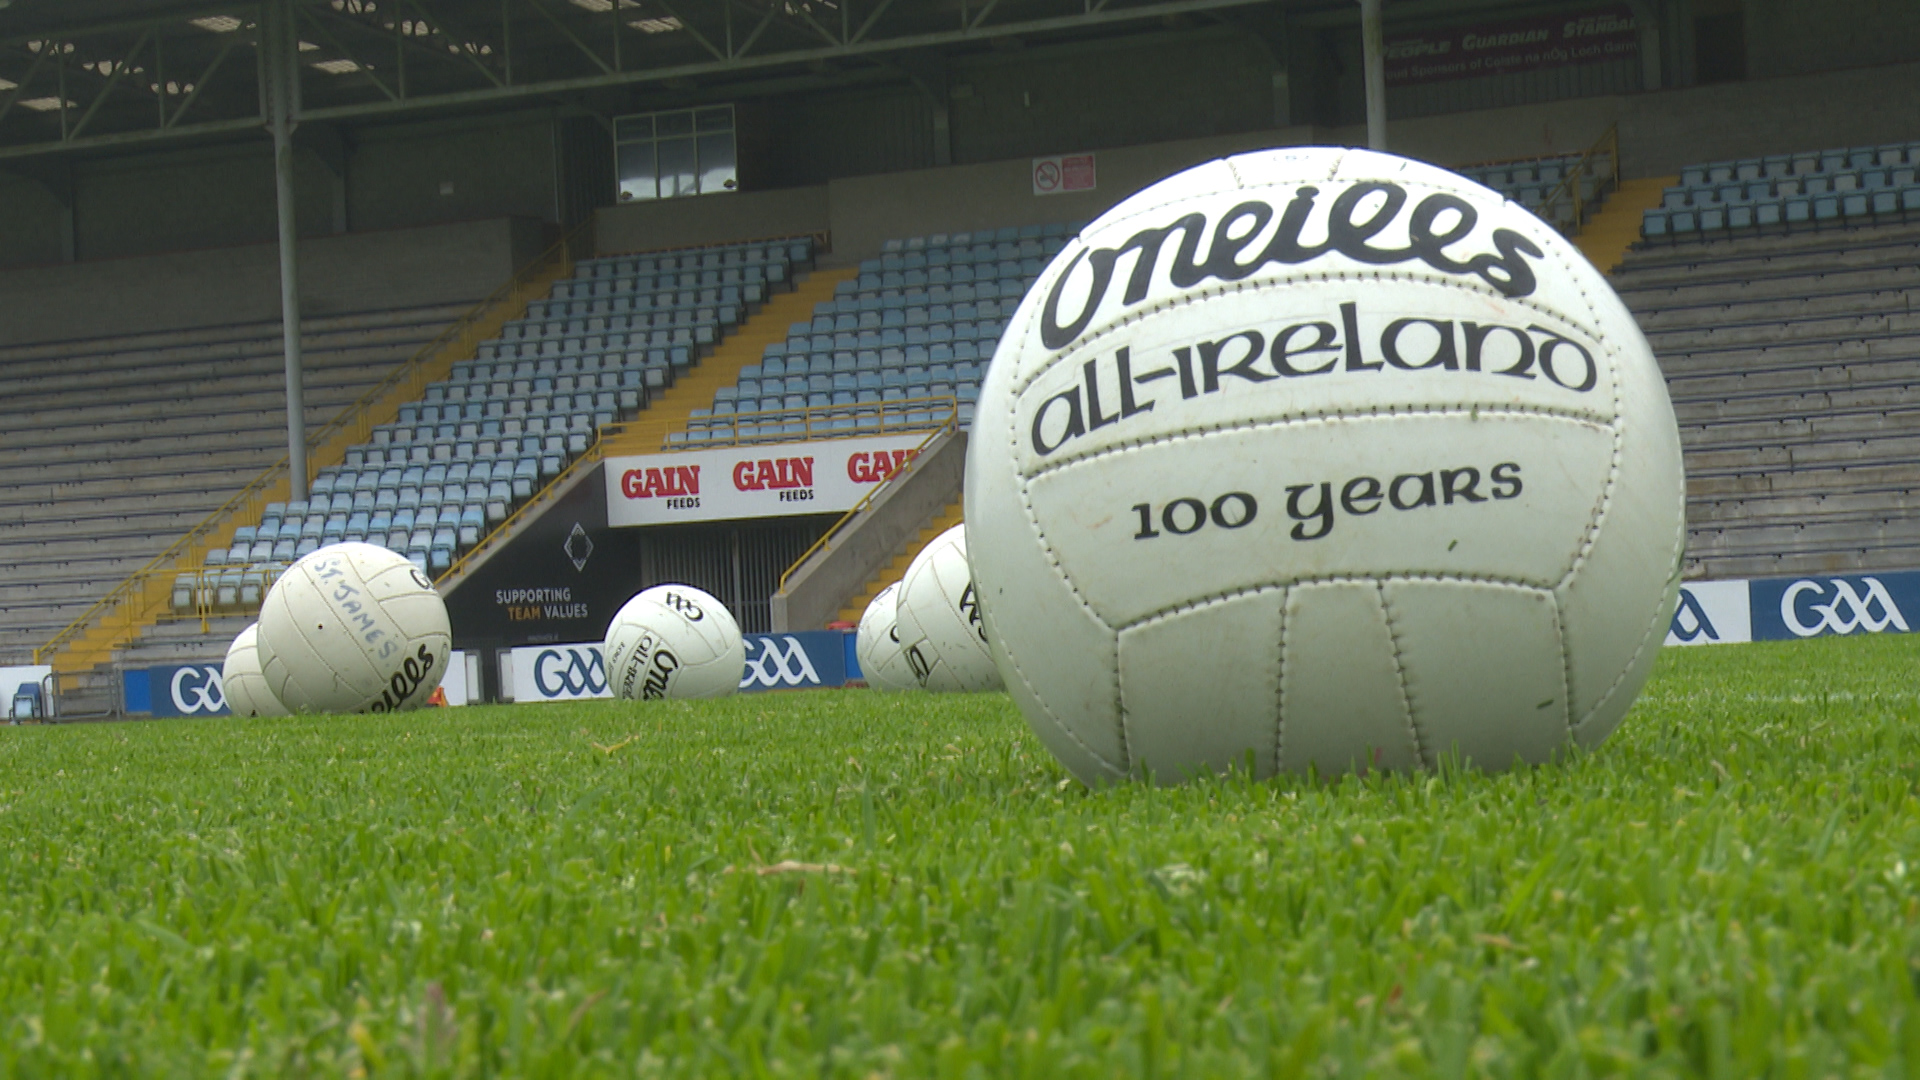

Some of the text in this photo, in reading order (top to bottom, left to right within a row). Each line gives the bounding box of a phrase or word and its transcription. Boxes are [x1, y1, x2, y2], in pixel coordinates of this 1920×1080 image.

[1470, 58, 1482, 70] of
[621, 465, 700, 499] GAIN
[733, 456, 814, 491] GAIN
[667, 489, 814, 509] FEEDS FEEDS
[1131, 492, 1258, 540] 100
[495, 587, 571, 604] SUPPORTING
[508, 603, 588, 620] TEAM VALUES
[1780, 577, 1910, 637] GAA
